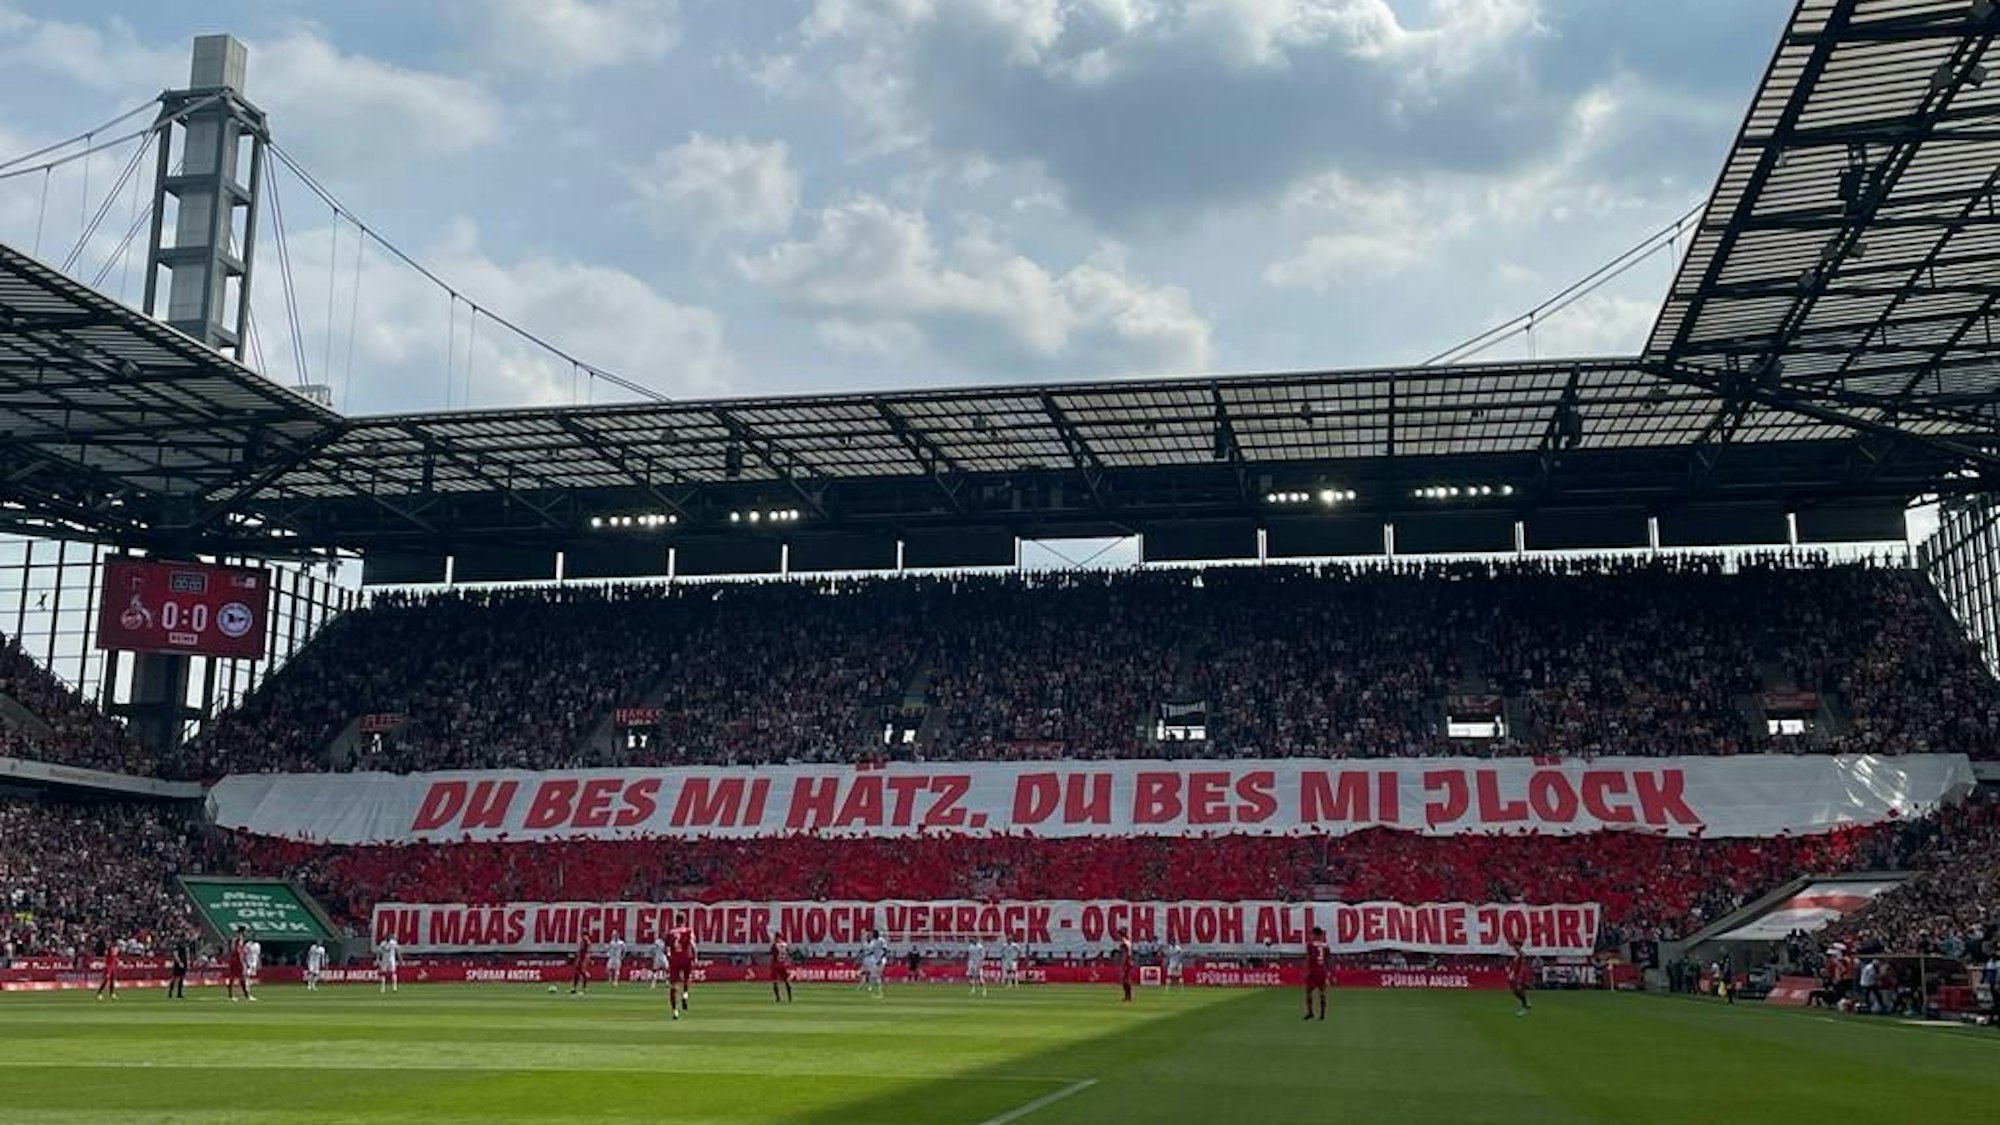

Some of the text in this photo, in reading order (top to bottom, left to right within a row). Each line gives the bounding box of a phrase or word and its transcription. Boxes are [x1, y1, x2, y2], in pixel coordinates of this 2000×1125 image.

[162, 601, 208, 632] 0:0
[412, 756, 1702, 831] DU BES MI HÄTZ. DU BES MI JLÖCK
[375, 909, 420, 944] DU
[534, 907, 627, 943] MICH
[779, 907, 875, 943] NOCH
[1060, 918, 1073, 928] -
[1081, 905, 1155, 942] OCH
[1166, 906, 1243, 944] NOH
[1337, 908, 1468, 945] DENNE
[1477, 908, 1595, 948] JOHR!
